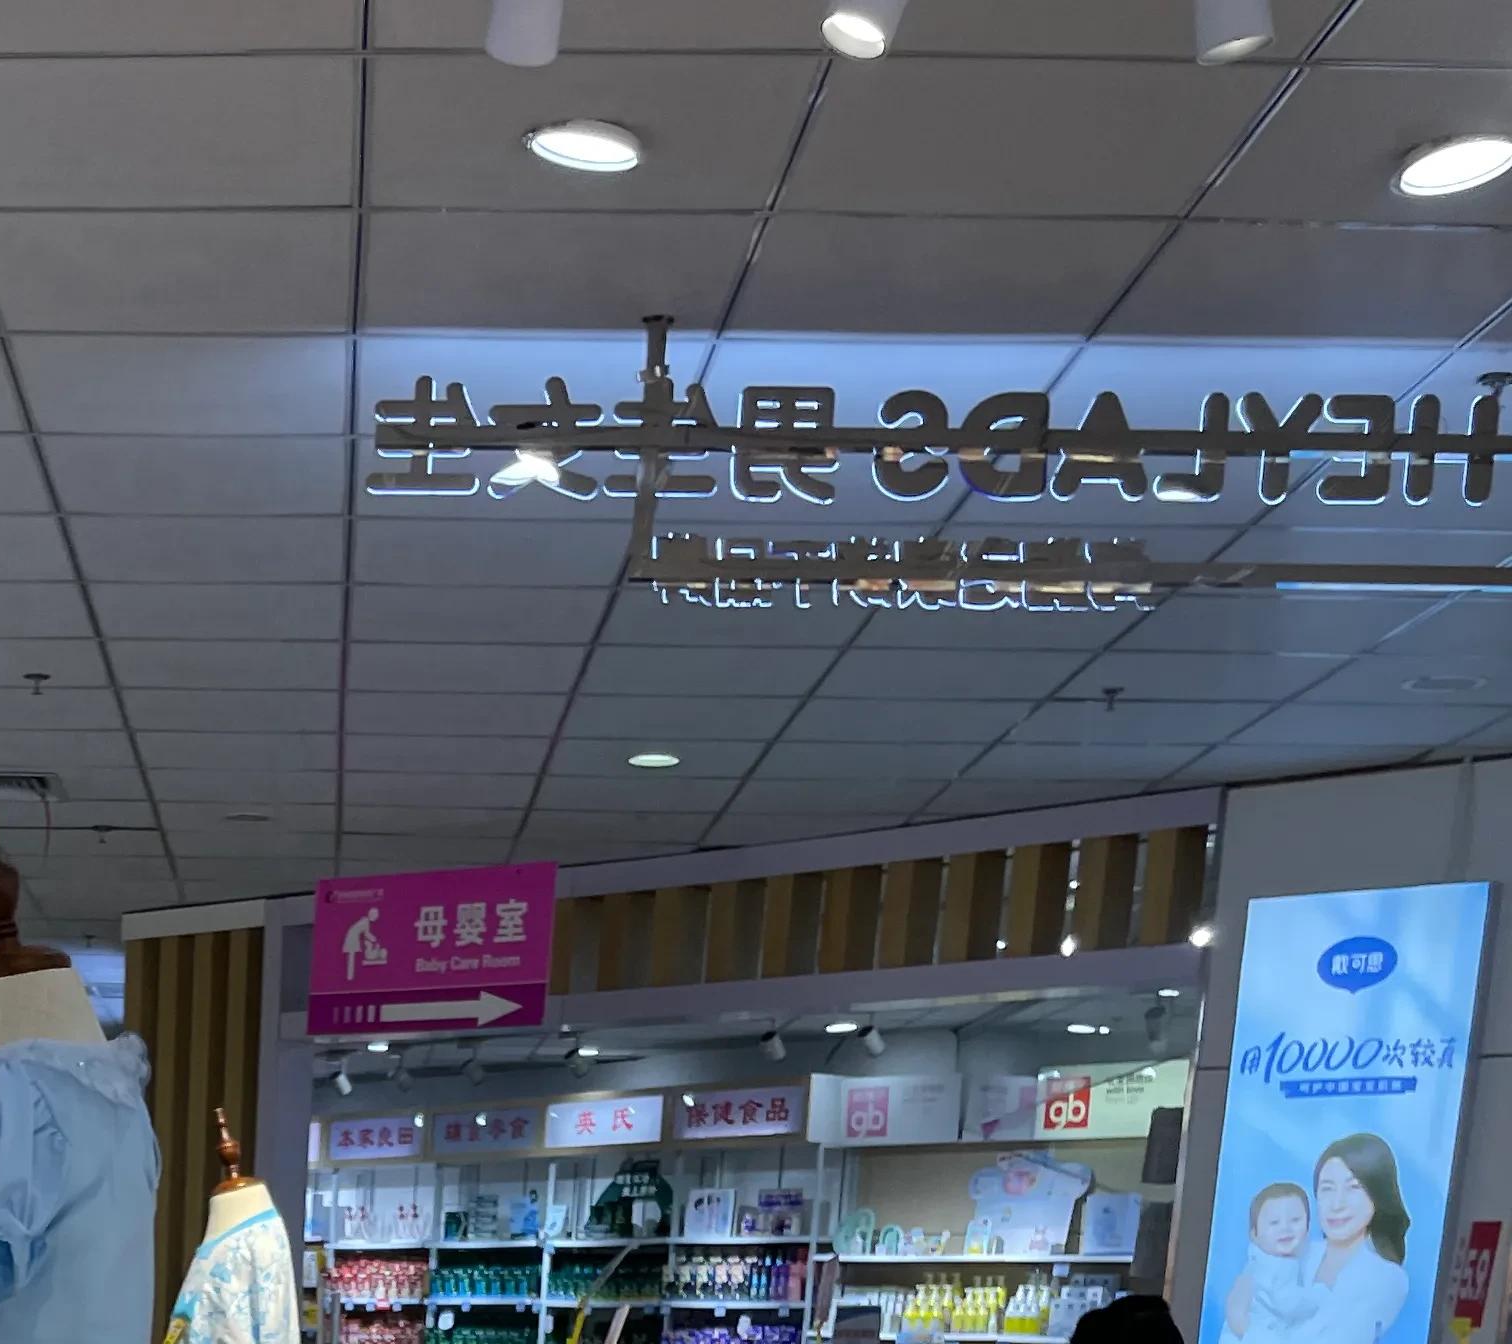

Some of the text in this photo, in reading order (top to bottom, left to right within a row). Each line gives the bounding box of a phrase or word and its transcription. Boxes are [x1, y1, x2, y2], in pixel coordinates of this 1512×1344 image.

[414, 898, 529, 948] 母婴室
[415, 953, 521, 973] Baby Care Room
[1049, 1092, 1086, 1130] gb
